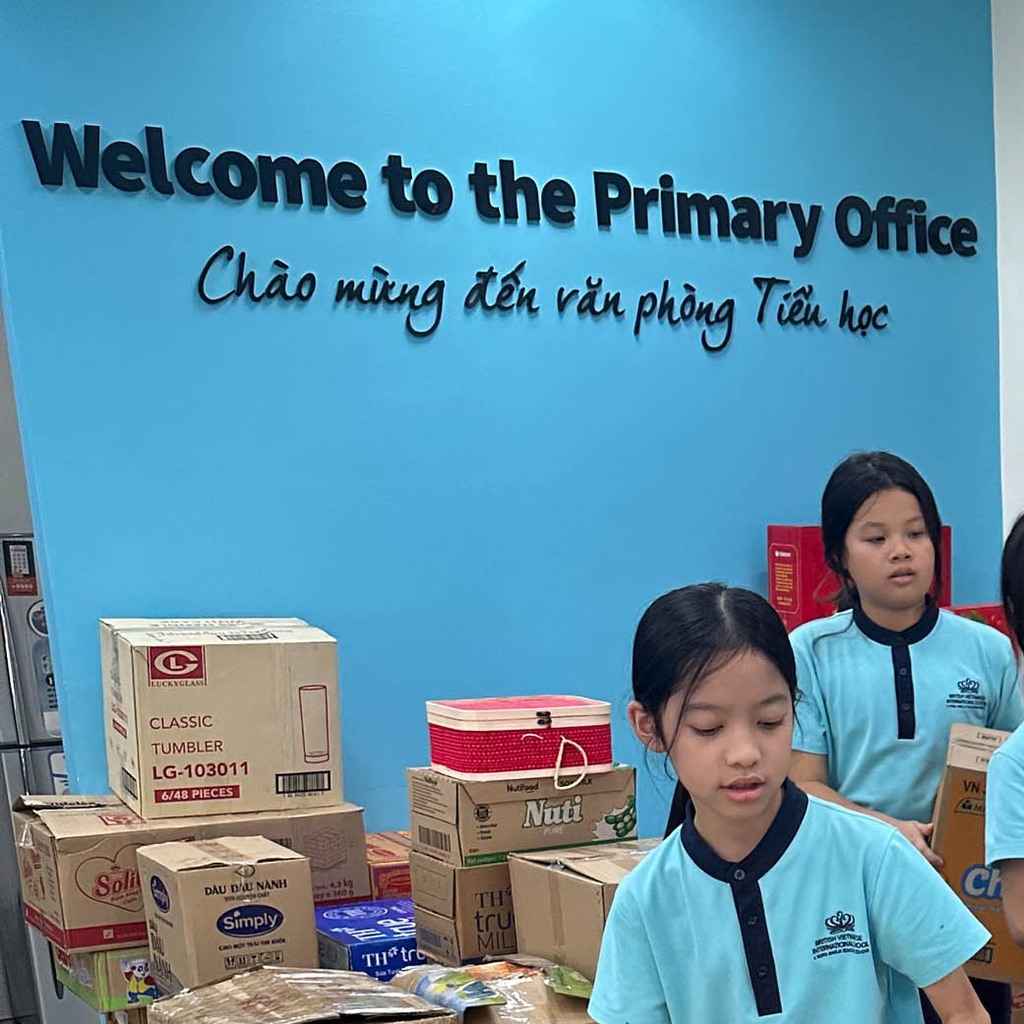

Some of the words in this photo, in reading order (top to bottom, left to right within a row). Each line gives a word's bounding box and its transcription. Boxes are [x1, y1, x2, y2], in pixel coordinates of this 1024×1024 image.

[21, 119, 368, 209] Welcome
[381, 154, 454, 217] to
[468, 158, 576, 227] the
[592, 170, 823, 258] Primary
[835, 194, 979, 258] Office
[196, 244, 316, 306] Chào
[334, 265, 446, 338] mừng
[463, 259, 540, 315] đến
[556, 275, 626, 320] văn
[634, 279, 736, 353] phòng
[839, 289, 889, 338] học
[149, 715, 214, 730] CLASSIC
[151, 740, 224, 756] TUMBLER
[152, 761, 249, 780] LG-103011
[161, 789, 189, 801] 6/48
[191, 787, 234, 799] PIECES
[963, 780, 981, 794] VN
[521, 794, 584, 830] Nuti
[94, 868, 141, 898] Soli
[474, 888, 505, 909] TH
[222, 910, 279, 931] Simply
[474, 910, 514, 932] tru
[476, 933, 518, 953] MIL
[361, 949, 388, 968] TH
[400, 946, 426, 963] tru
